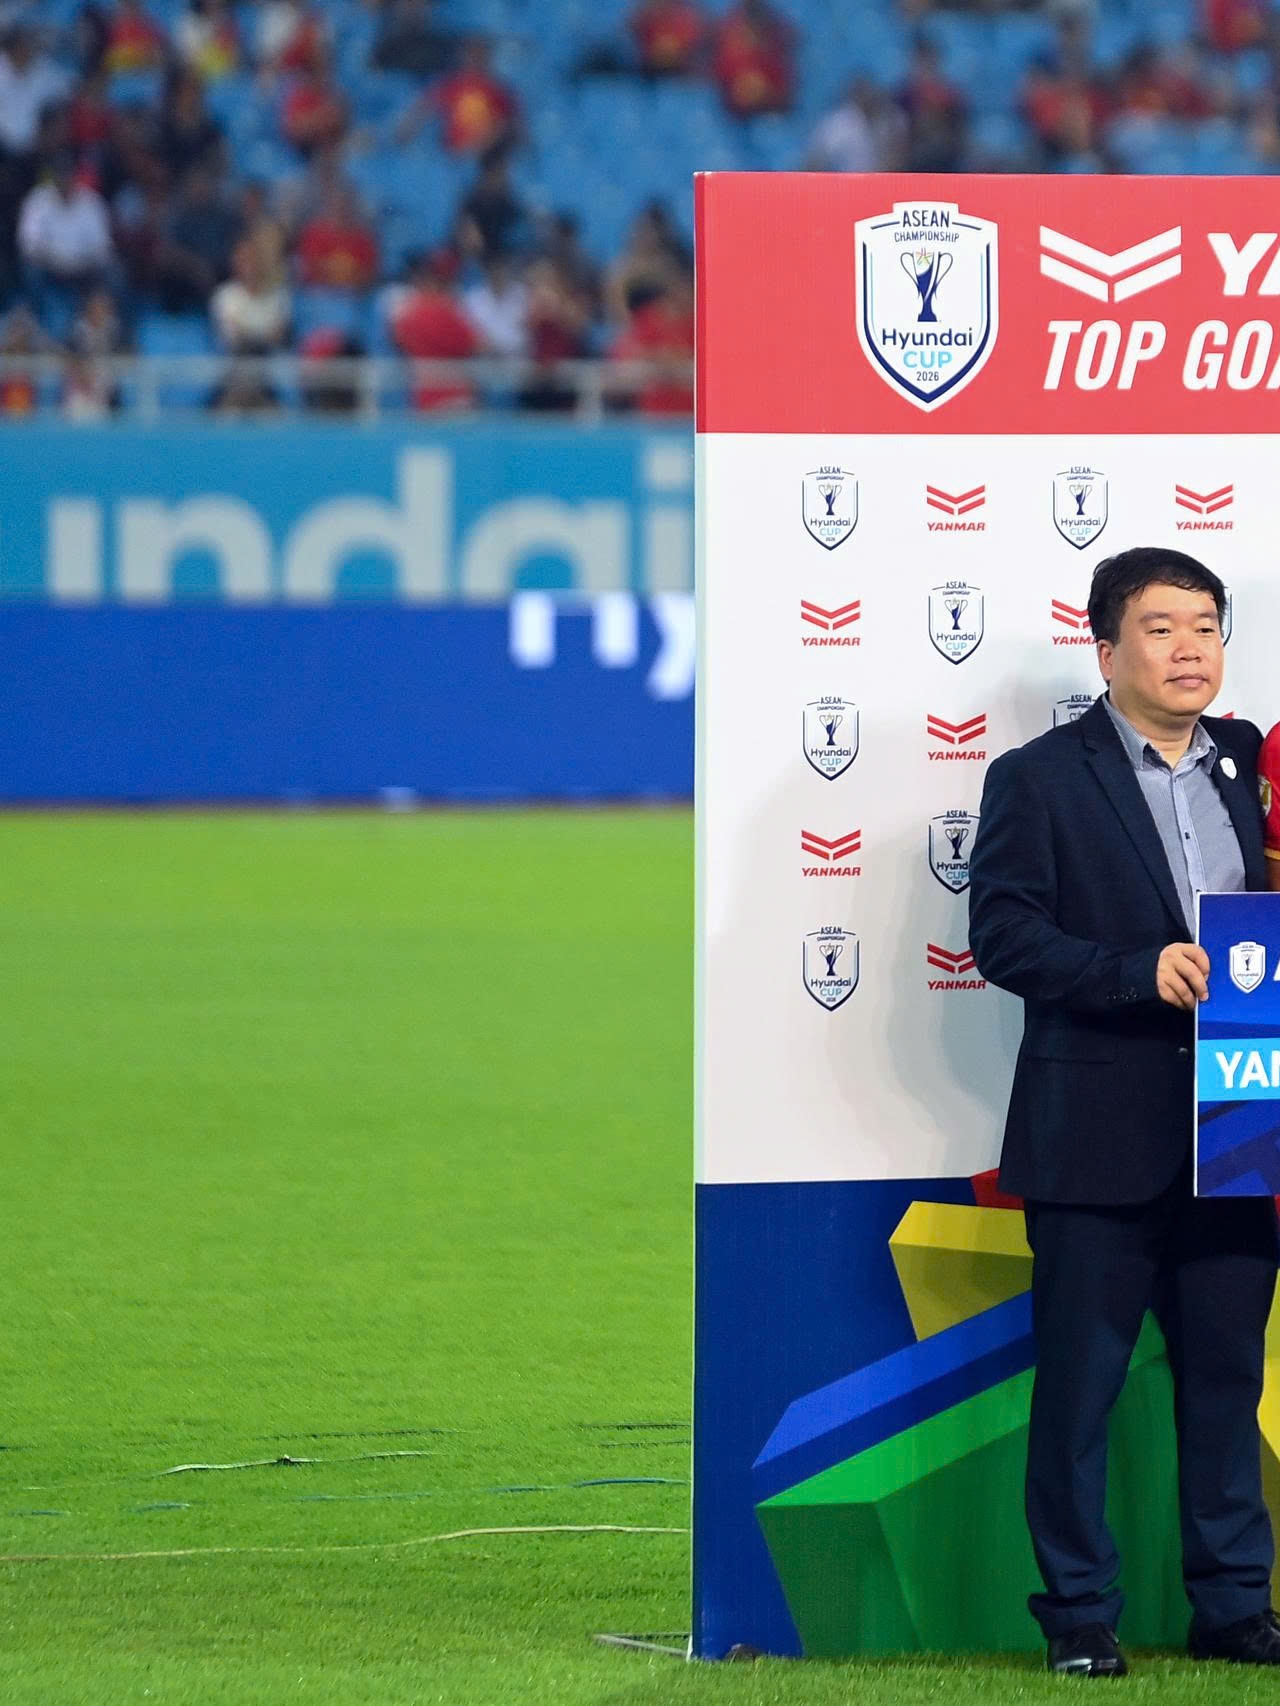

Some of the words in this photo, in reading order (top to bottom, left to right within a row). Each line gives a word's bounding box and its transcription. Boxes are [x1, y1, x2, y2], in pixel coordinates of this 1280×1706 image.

[902, 209, 951, 229] ASEAN
[894, 230, 960, 244] CHAMPIONSHIP
[882, 326, 974, 351] Hyundai
[902, 350, 953, 369] CUP
[1043, 319, 1167, 391] TOP
[915, 370, 940, 382] 2026
[810, 517, 851, 528] Hyundai
[928, 521, 986, 531] YANMAR
[1060, 517, 1101, 528] Hyundai
[1176, 520, 1234, 530] YANMAR
[819, 527, 842, 537] CUP
[1069, 527, 1092, 537] CUP
[802, 637, 861, 647] YANMAR
[936, 631, 977, 642] Hyundai
[1052, 635, 1097, 645] YANM
[945, 641, 968, 651] CUP
[1070, 694, 1092, 704] ASEAN
[811, 747, 852, 758] Hyundai
[927, 751, 987, 761] YANMAR
[820, 757, 843, 767] CUP
[802, 866, 861, 877] YANMAR
[936, 861, 969, 872] Hyund
[946, 871, 969, 881] CUP
[811, 977, 852, 988] Hyundai
[927, 980, 987, 991] YANMAR
[820, 987, 843, 997] CUP
